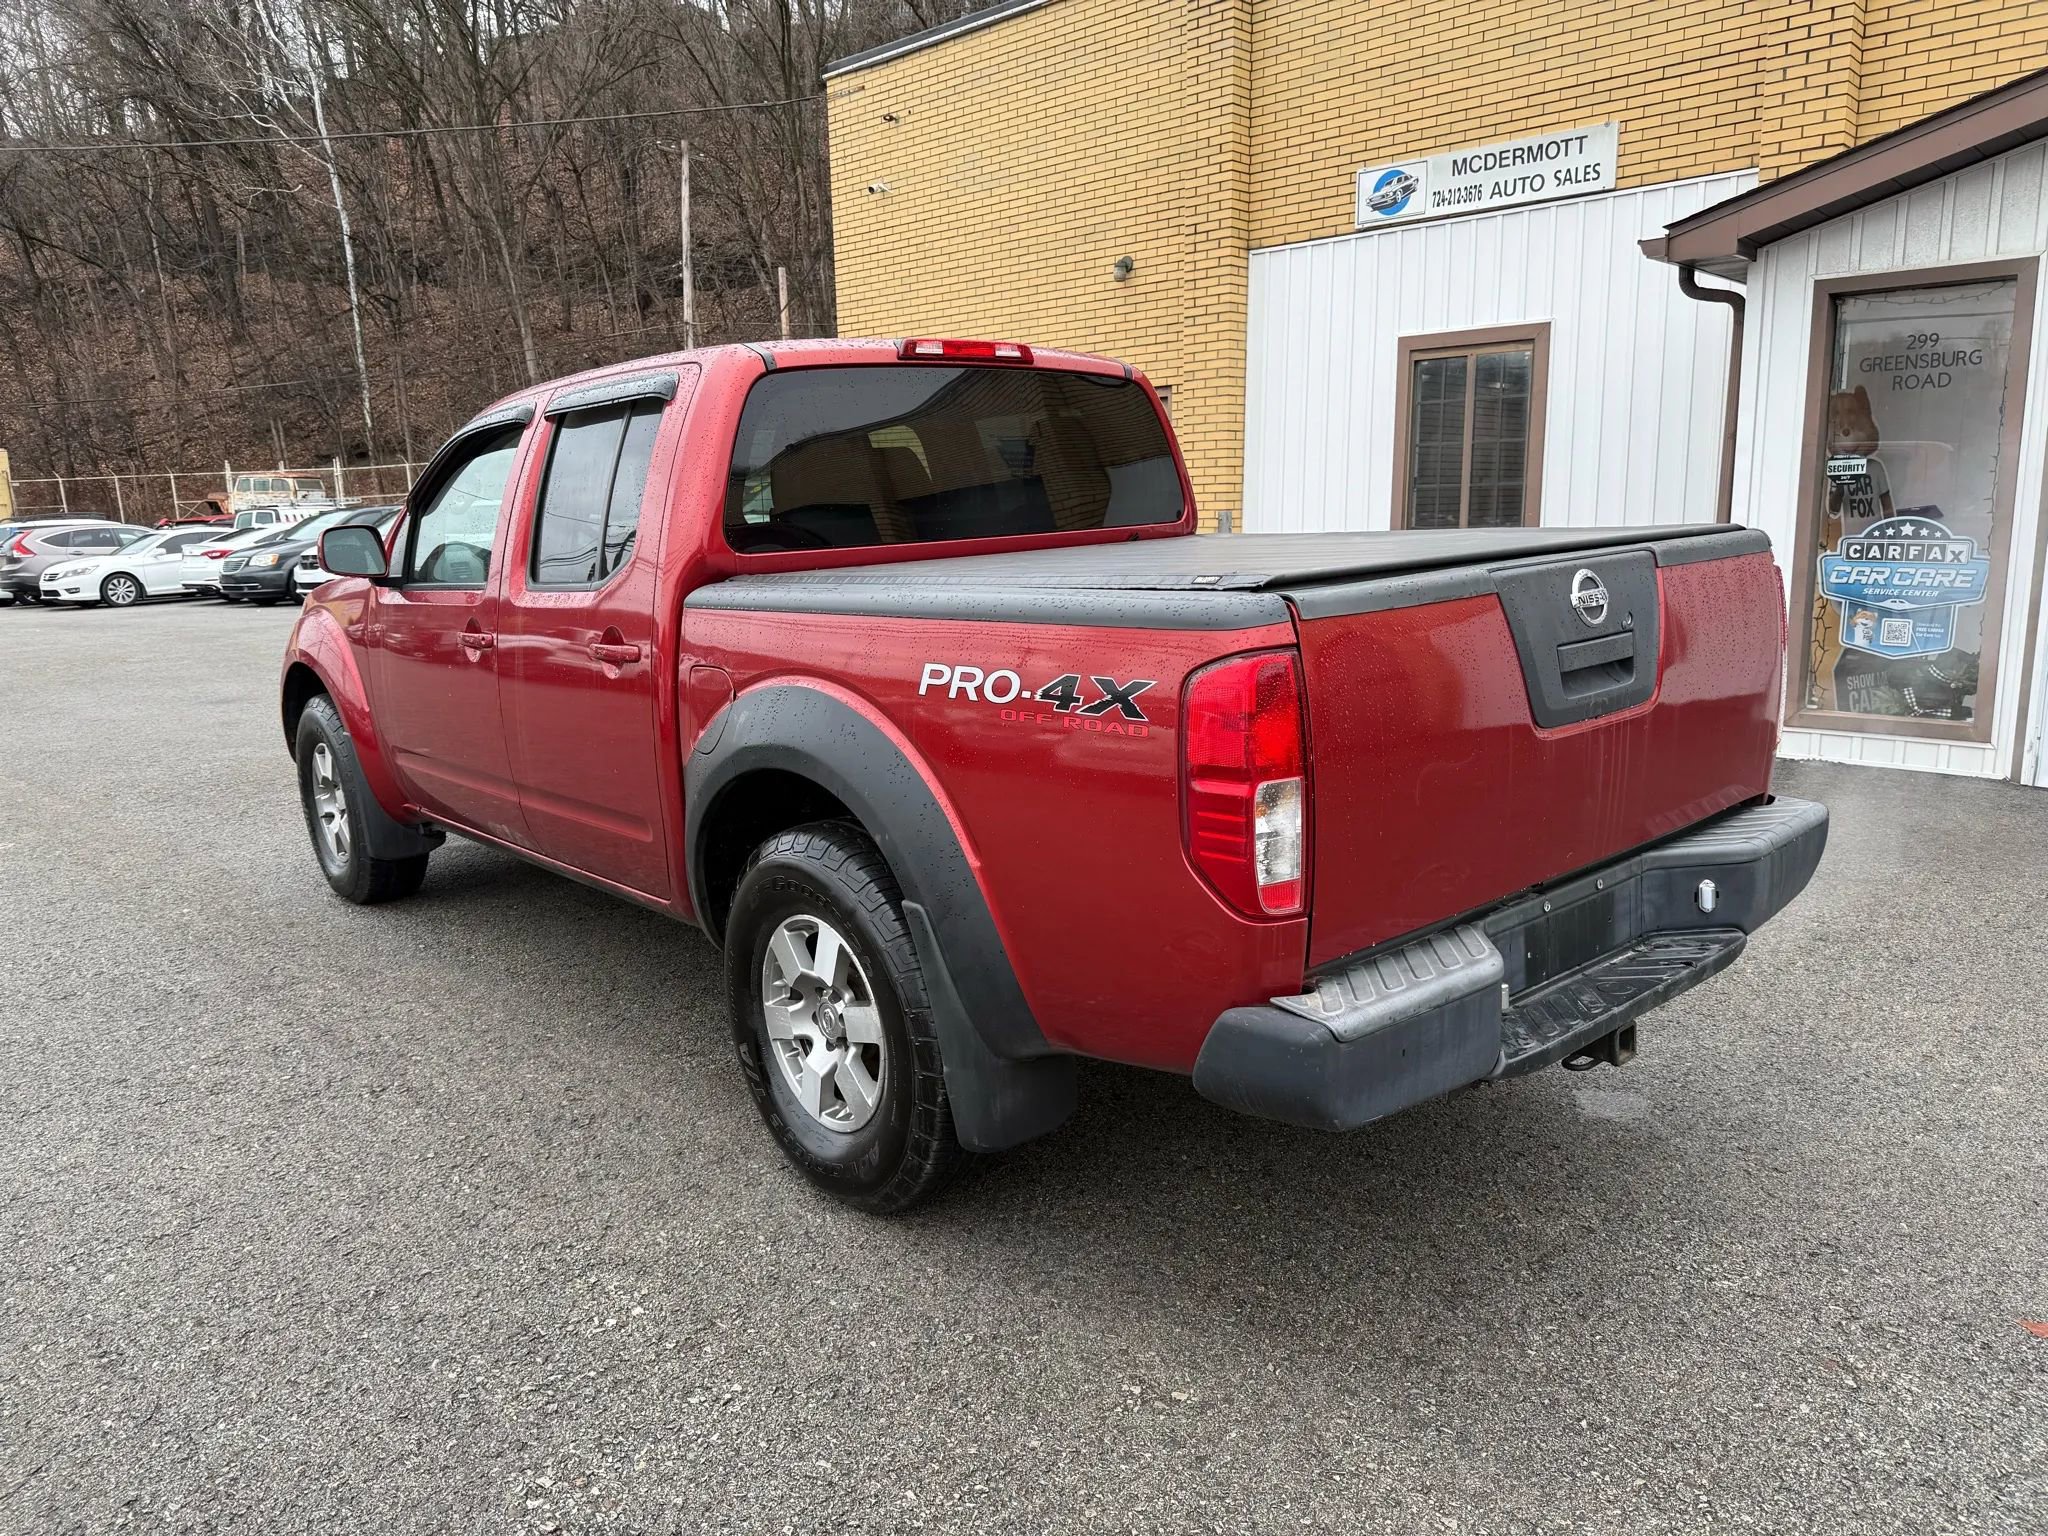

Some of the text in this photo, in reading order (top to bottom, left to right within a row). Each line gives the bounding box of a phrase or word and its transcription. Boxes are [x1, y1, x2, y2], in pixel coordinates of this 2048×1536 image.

[1451, 134, 1589, 177] MCDERMOTT
[1432, 162, 1601, 208] 724-212-3676 AUTO SALES
[1906, 332, 1940, 350] 299
[1859, 349, 1983, 373] GREENSBURG
[1892, 372, 1952, 391] ROAD
[1827, 463, 1866, 474] SECURITY
[1849, 497, 1875, 518] FOX
[1849, 544, 1966, 564] CARFAX
[1829, 566, 1977, 588] CAR CARE
[1862, 587, 1940, 598] SERVICE CENTER
[1846, 672, 1874, 690] SHOW
[1000, 709, 1149, 738] OFF ROAD
